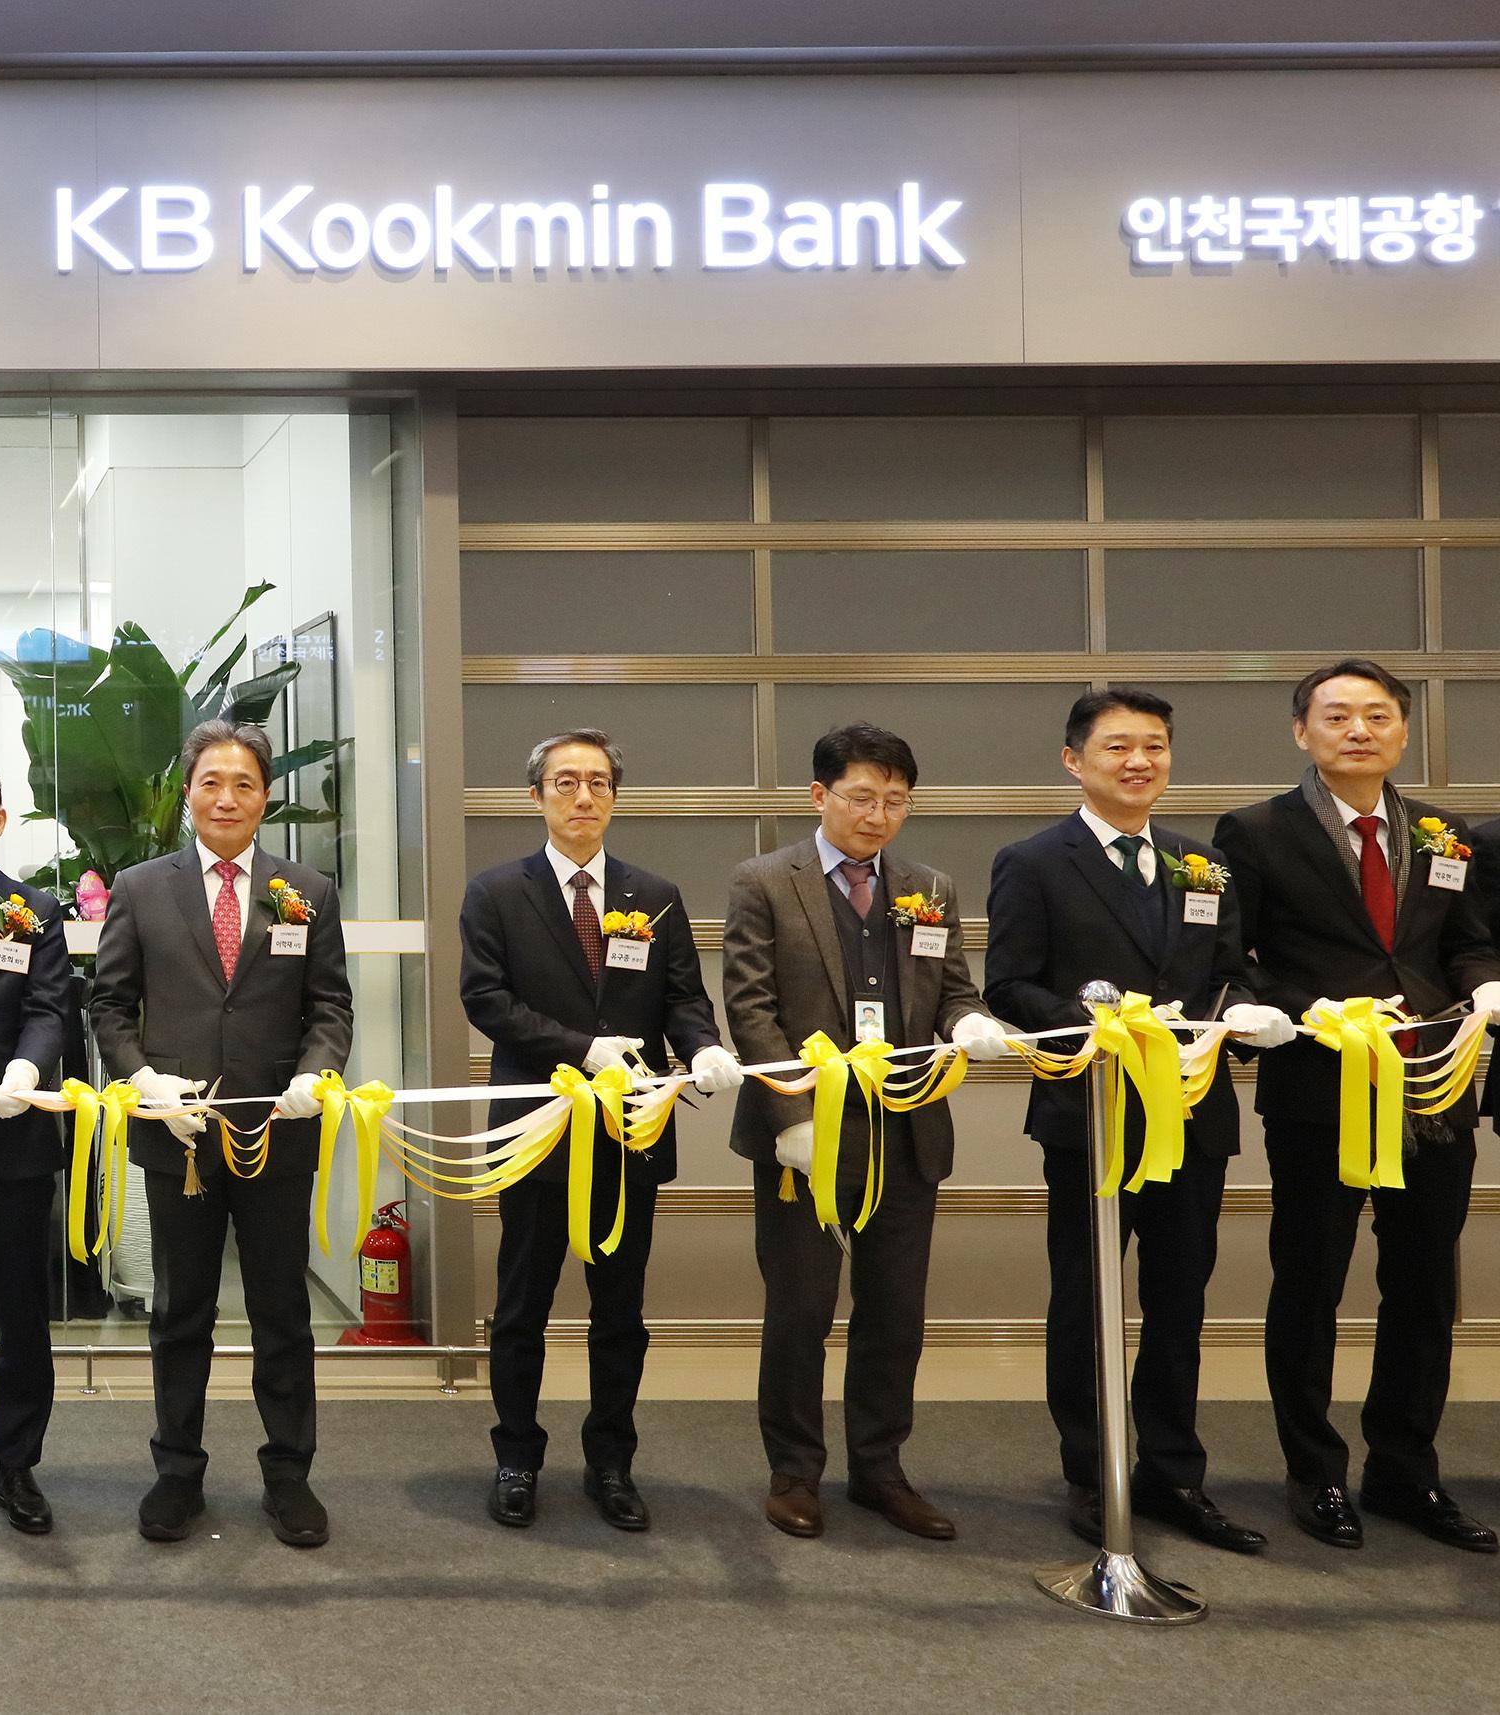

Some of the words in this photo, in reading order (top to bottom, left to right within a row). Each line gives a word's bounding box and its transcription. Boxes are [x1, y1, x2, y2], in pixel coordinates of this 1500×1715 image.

[55, 185, 215, 272] KB
[243, 183, 674, 273] Kookmin
[701, 181, 967, 269] Bank
[1124, 192, 1484, 265] 인천국제공항
